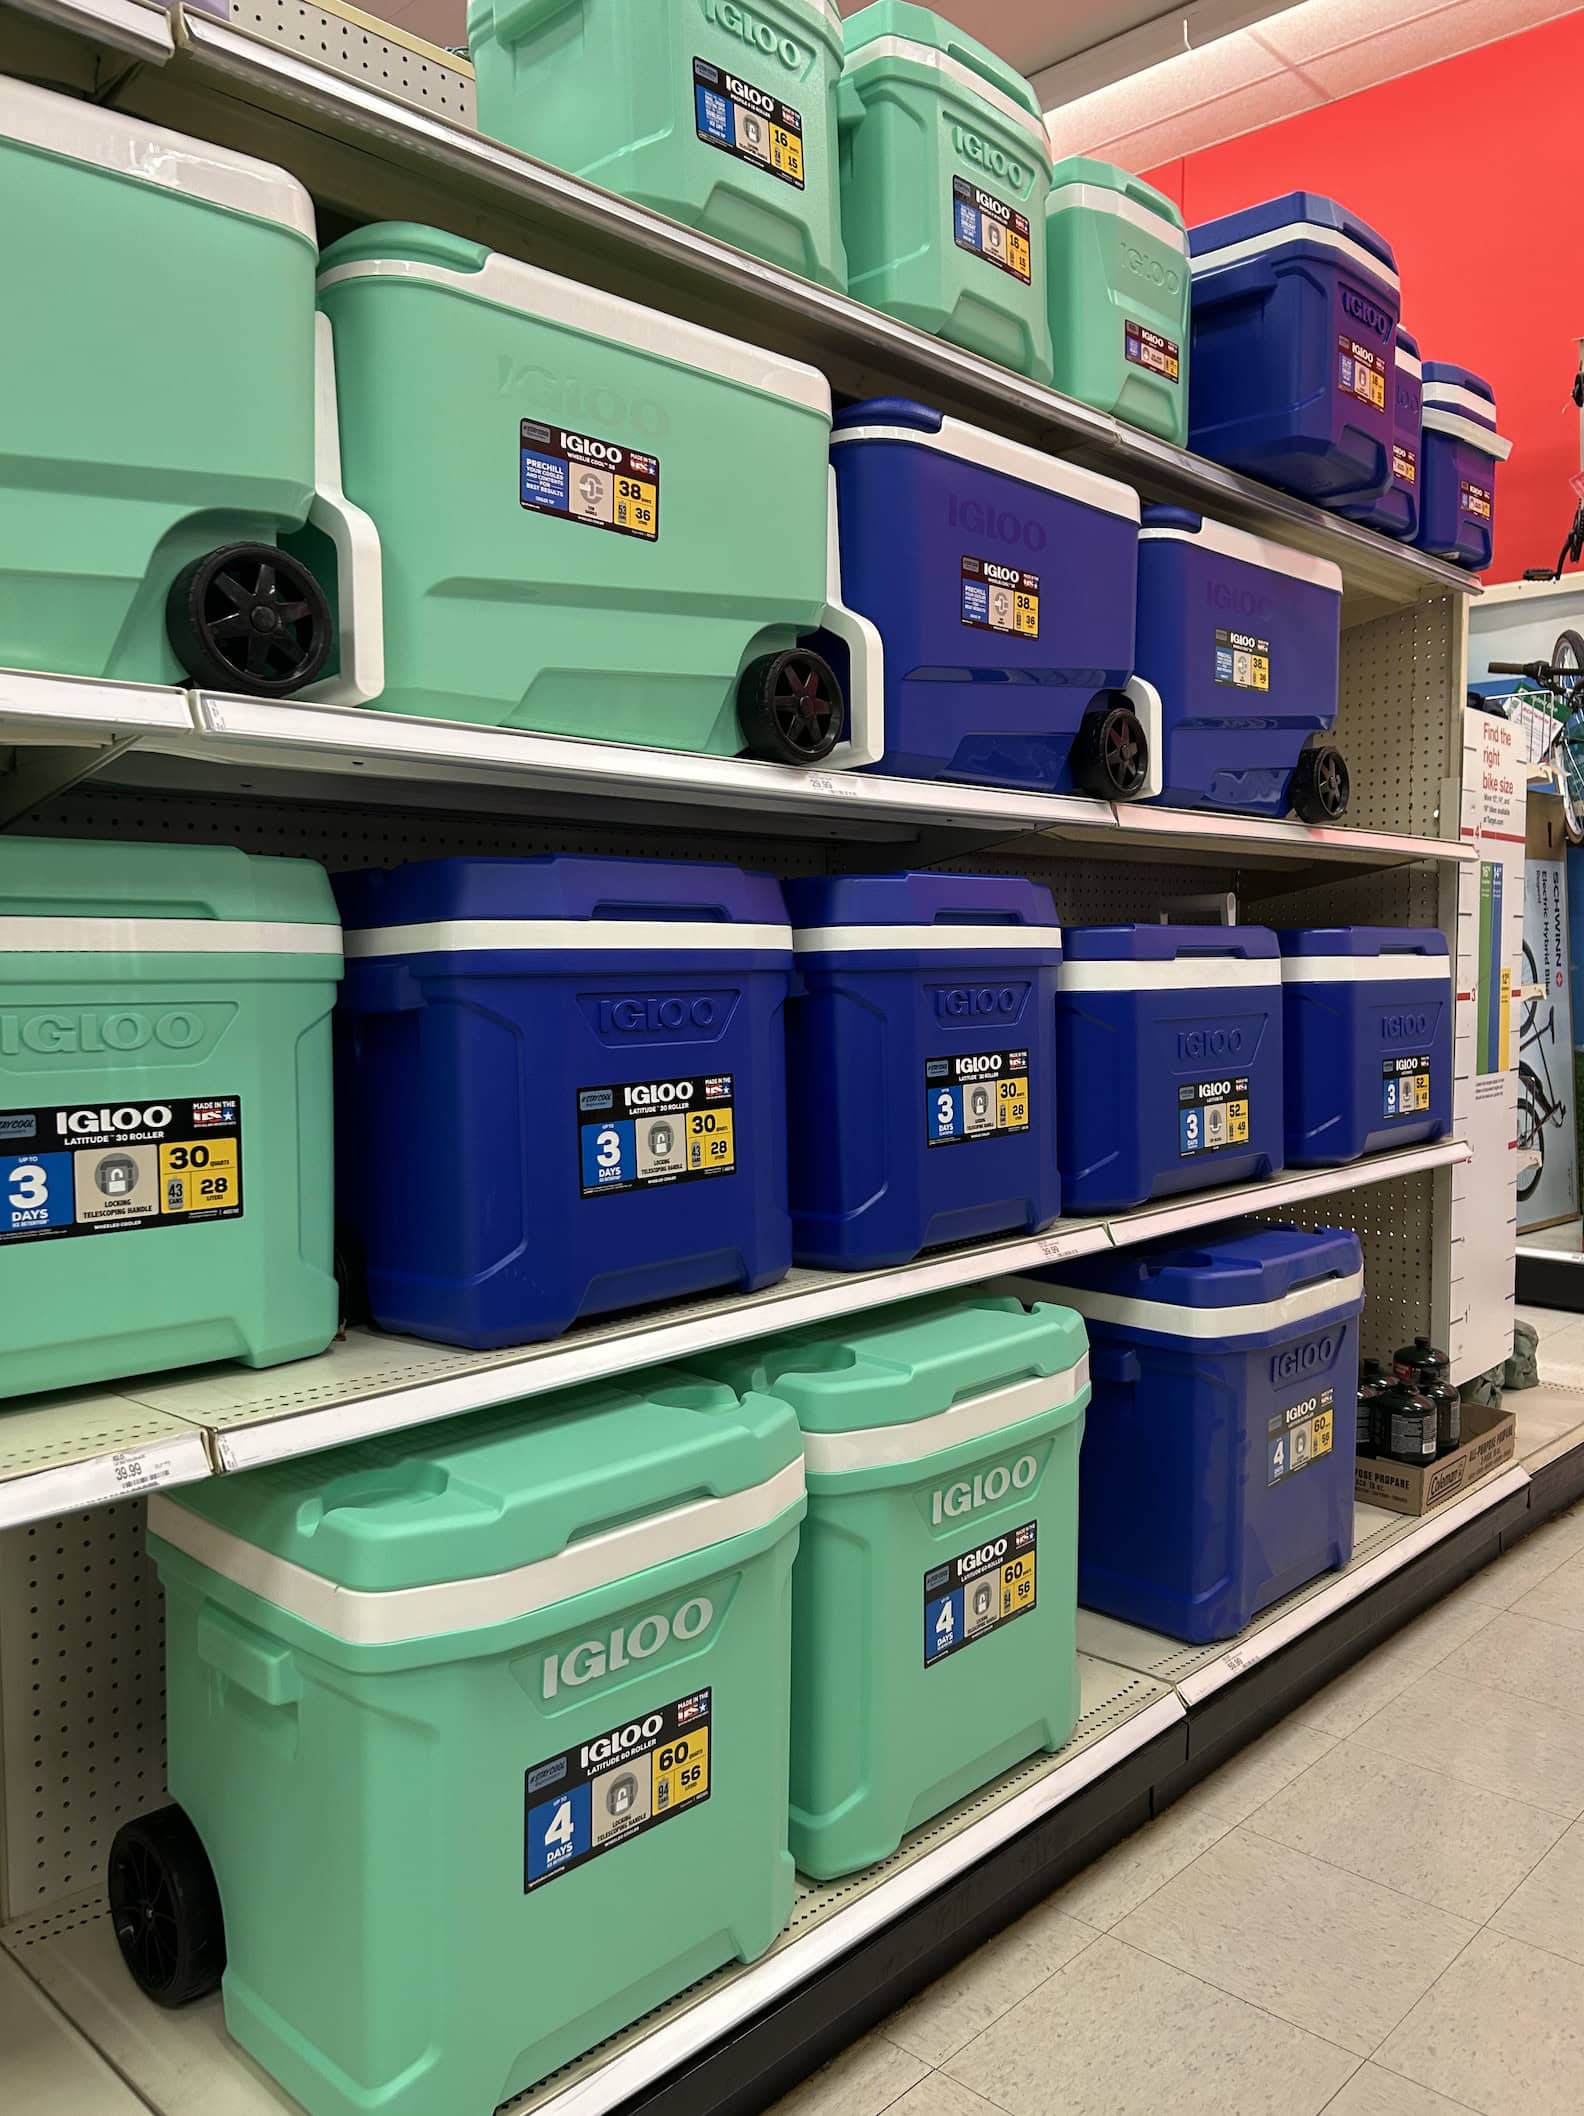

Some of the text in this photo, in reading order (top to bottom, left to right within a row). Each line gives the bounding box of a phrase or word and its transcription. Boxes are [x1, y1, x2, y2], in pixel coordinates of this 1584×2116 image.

[701, 0, 801, 70] IGLOO
[725, 75, 775, 112] IGLOO
[774, 130, 788, 147] 16
[788, 156, 798, 169] 15
[952, 125, 1022, 189] IGLOO
[975, 189, 1010, 220] IGLOO
[1010, 234, 1020, 249] 16
[1120, 242, 1180, 295] IGLOO
[1342, 289, 1389, 336] IGLOO
[1141, 329, 1165, 348] IGLOO
[1351, 342, 1374, 364] IGLOO
[497, 352, 672, 438] IGLOO
[560, 432, 623, 464] IGLOO
[526, 457, 564, 475] PRECHILL
[619, 480, 642, 500] 38
[635, 507, 651, 521] 36
[947, 494, 1047, 551] IGLOO
[983, 562, 1020, 584] IGLOO
[1017, 595, 1030, 610] 38
[1026, 615, 1036, 625] 36
[1230, 631, 1256, 649] IGLOO
[1253, 657, 1263, 670] 38
[1483, 721, 1512, 748] Find the
[1483, 746, 1500, 769] right
[1482, 773, 1514, 796] bike size
[1552, 871, 1562, 967] SCHWINN
[935, 987, 1014, 1017] IGLOO
[599, 997, 713, 1034] IGLOO
[0, 1011, 205, 1056] IGLOO
[1382, 1015, 1426, 1039] IGLOO
[1177, 1028, 1242, 1060] IGLOO
[955, 1055, 1002, 1075] IGLOO
[1395, 1058, 1418, 1071] IGLOO
[624, 1081, 694, 1107] IGLOO
[1000, 1082, 1017, 1099] 30
[1199, 1081, 1231, 1098] IGLOO
[1387, 1083, 1396, 1105] 3
[193, 1100, 236, 1110] MADE IN THE
[668, 1102, 690, 1111] ROLLER
[937, 1093, 954, 1124] 3
[1012, 1104, 1024, 1116] 28
[1229, 1103, 1240, 1118] 52
[56, 1105, 173, 1135] IGLOO
[692, 1114, 716, 1134] 30
[938, 1123, 954, 1132] DAYS
[1186, 1113, 1198, 1140] 3
[1237, 1121, 1246, 1131] 49
[116, 1133, 129, 1142] 30
[129, 1130, 165, 1141] ROLLER
[169, 1145, 210, 1170] 30
[596, 1130, 621, 1167] 3
[711, 1140, 728, 1155] 28
[598, 1167, 622, 1178] DAYS
[8, 1164, 49, 1209] 3
[168, 1183, 183, 1198] 43
[200, 1177, 228, 1196] 28
[83, 1205, 152, 1219] TELESCOPING HANDLE
[104, 1199, 131, 1209] LOCKING
[11, 1209, 49, 1222] DAYS
[94, 1220, 142, 1231] WHEELED COOLER
[1270, 1336, 1335, 1382] IGLOO
[1286, 1398, 1317, 1424] IGLOO
[1313, 1416, 1326, 1432] 60
[1273, 1439, 1285, 1465] 4
[115, 1462, 142, 1480] 39.99
[1374, 1472, 1409, 1490] PROPANE
[1431, 1469, 1458, 1495] Coleman
[932, 1455, 1038, 1525] IGLOO
[957, 1538, 1008, 1577] IGLOO
[987, 1557, 1004, 1569] ROLLER
[1004, 1561, 1023, 1583] 60
[1018, 1580, 1030, 1596] 56
[936, 1599, 954, 1634] 4
[543, 1597, 714, 1699] IGLOO
[937, 1632, 954, 1647] DAYS
[677, 1699, 692, 1710] MADE
[698, 1691, 709, 1700] THE
[580, 1714, 664, 1769] IGLOO
[587, 1738, 657, 1777] LATITUDE 60 ROLLER
[659, 1741, 689, 1771] 60
[681, 1765, 701, 1786] 56
[658, 1782, 669, 1798] 94
[544, 1800, 574, 1846] 4
[597, 1812, 646, 1842] TELESCOPING HANDLE
[612, 1814, 631, 1828] LOCKING
[546, 1841, 573, 1863] DAYS
